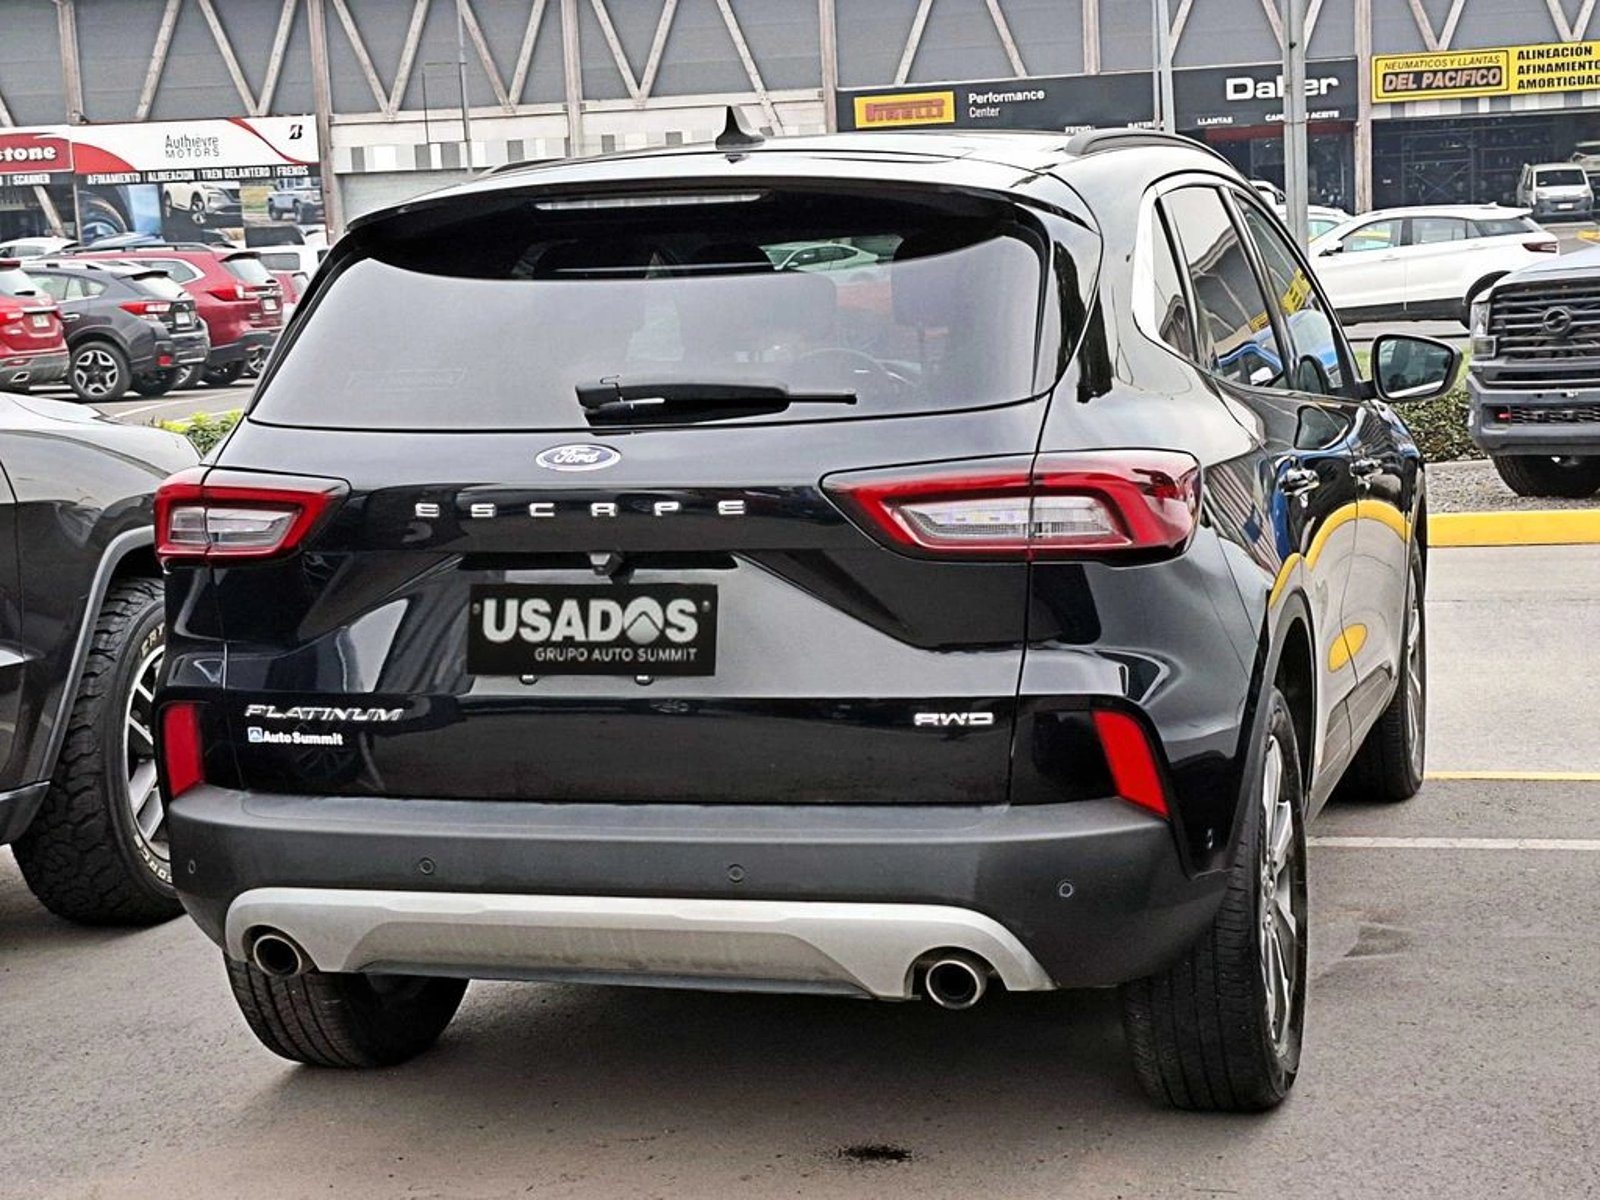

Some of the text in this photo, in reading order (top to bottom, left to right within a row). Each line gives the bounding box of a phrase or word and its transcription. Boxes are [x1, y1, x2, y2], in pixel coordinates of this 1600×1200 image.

[1384, 54, 1501, 70] NEUMATICOS Y LLANTAS
[1383, 68, 1501, 91] DEL PACIFICO
[968, 90, 1045, 104] Performance
[969, 107, 1001, 118] Center
[1197, 116, 1233, 126] LLANTAS
[165, 147, 219, 159] MOTORS
[201, 169, 223, 180] TREN
[277, 165, 309, 177] FRENOS
[415, 500, 746, 519] ESCAPE
[483, 597, 699, 645] USADOS
[534, 648, 698, 663] GRUPO AUTO SUMMIT
[245, 704, 404, 721] PLATINUM
[264, 731, 344, 745] Auto Summit
